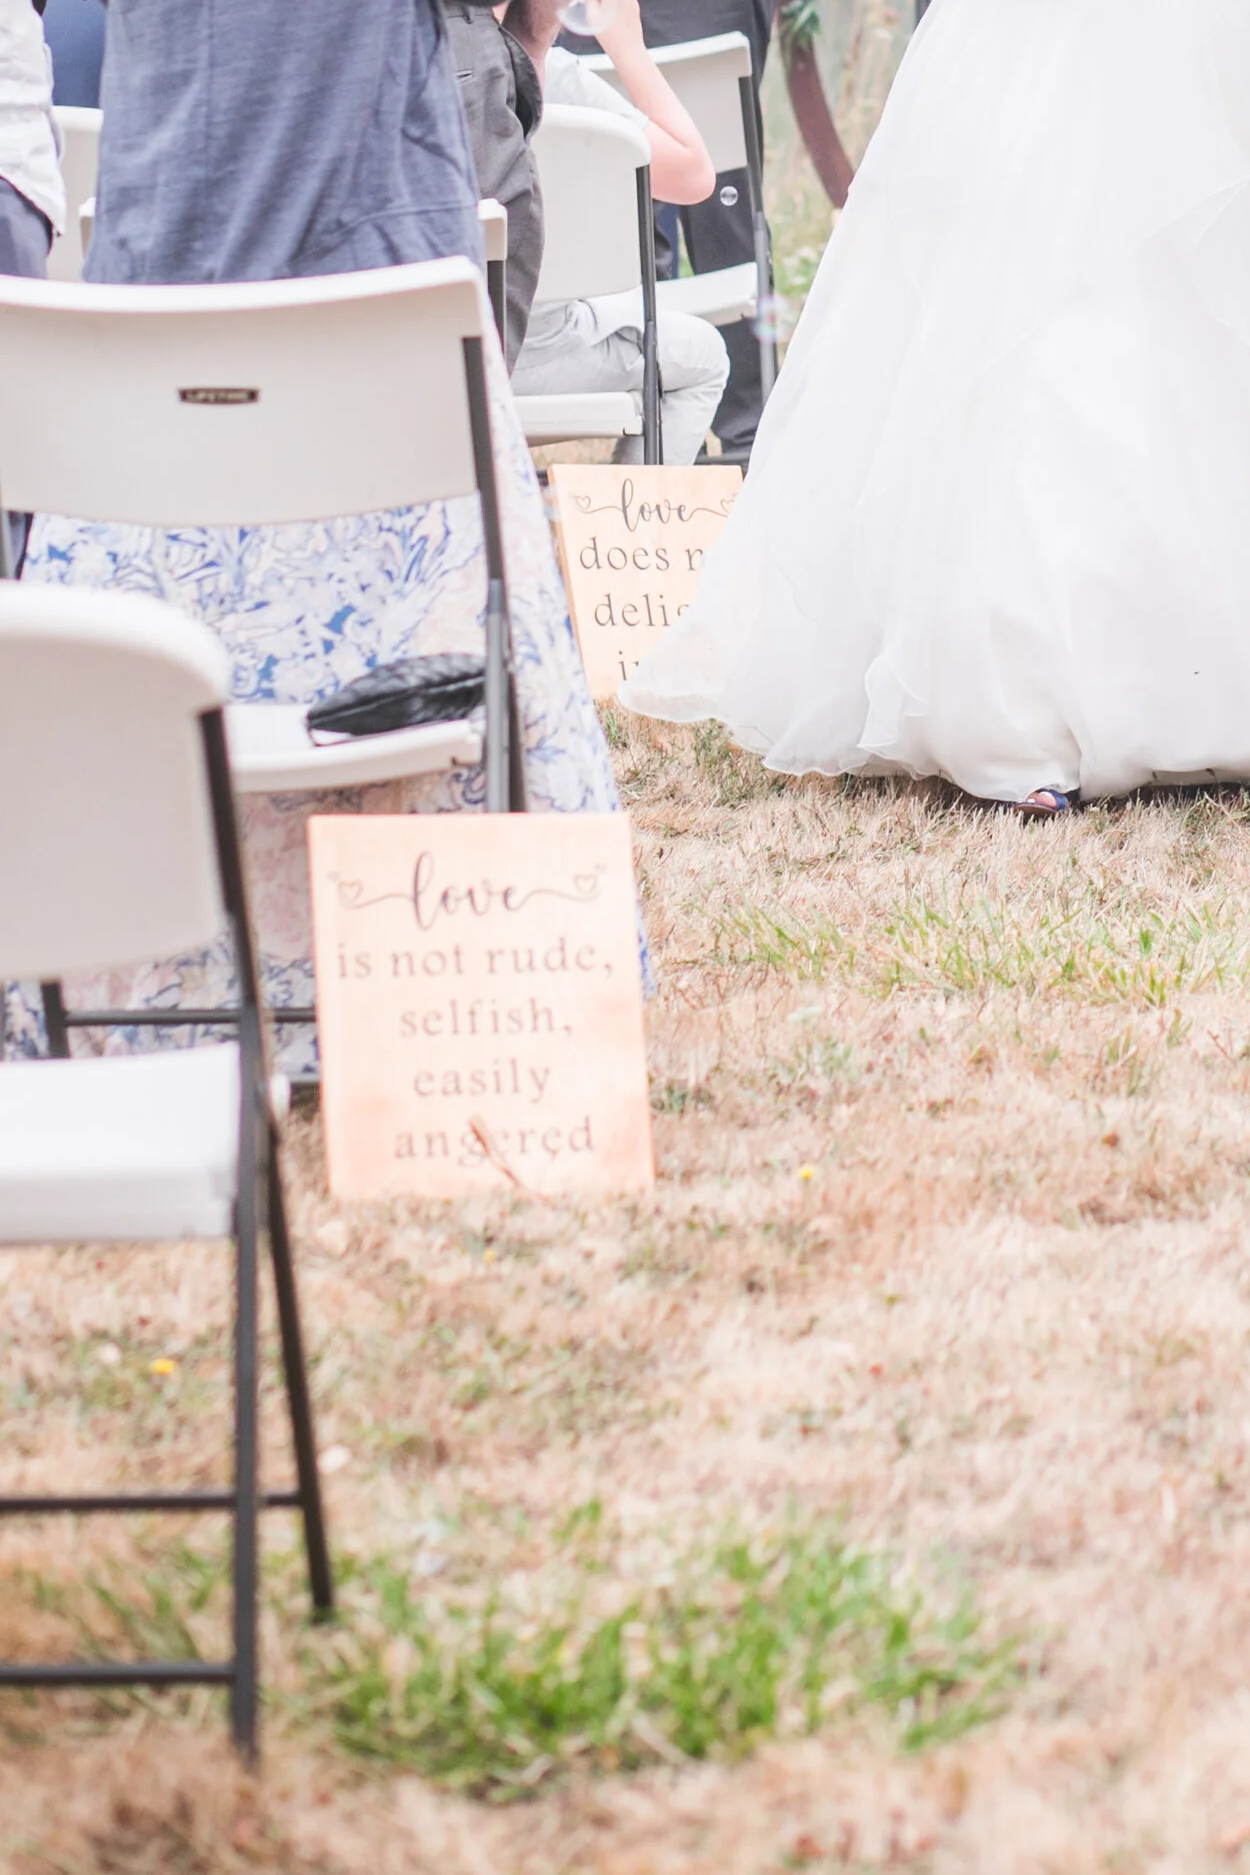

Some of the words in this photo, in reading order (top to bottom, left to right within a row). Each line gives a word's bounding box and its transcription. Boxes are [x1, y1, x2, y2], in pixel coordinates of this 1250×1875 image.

[621, 478, 691, 533] love
[579, 536, 670, 571] does
[413, 850, 520, 932] love
[337, 942, 373, 980] is
[390, 943, 464, 977] not
[485, 937, 614, 977] rude,
[399, 997, 573, 1039] selfish,
[413, 1059, 551, 1104] easily
[394, 1115, 595, 1168] angered
